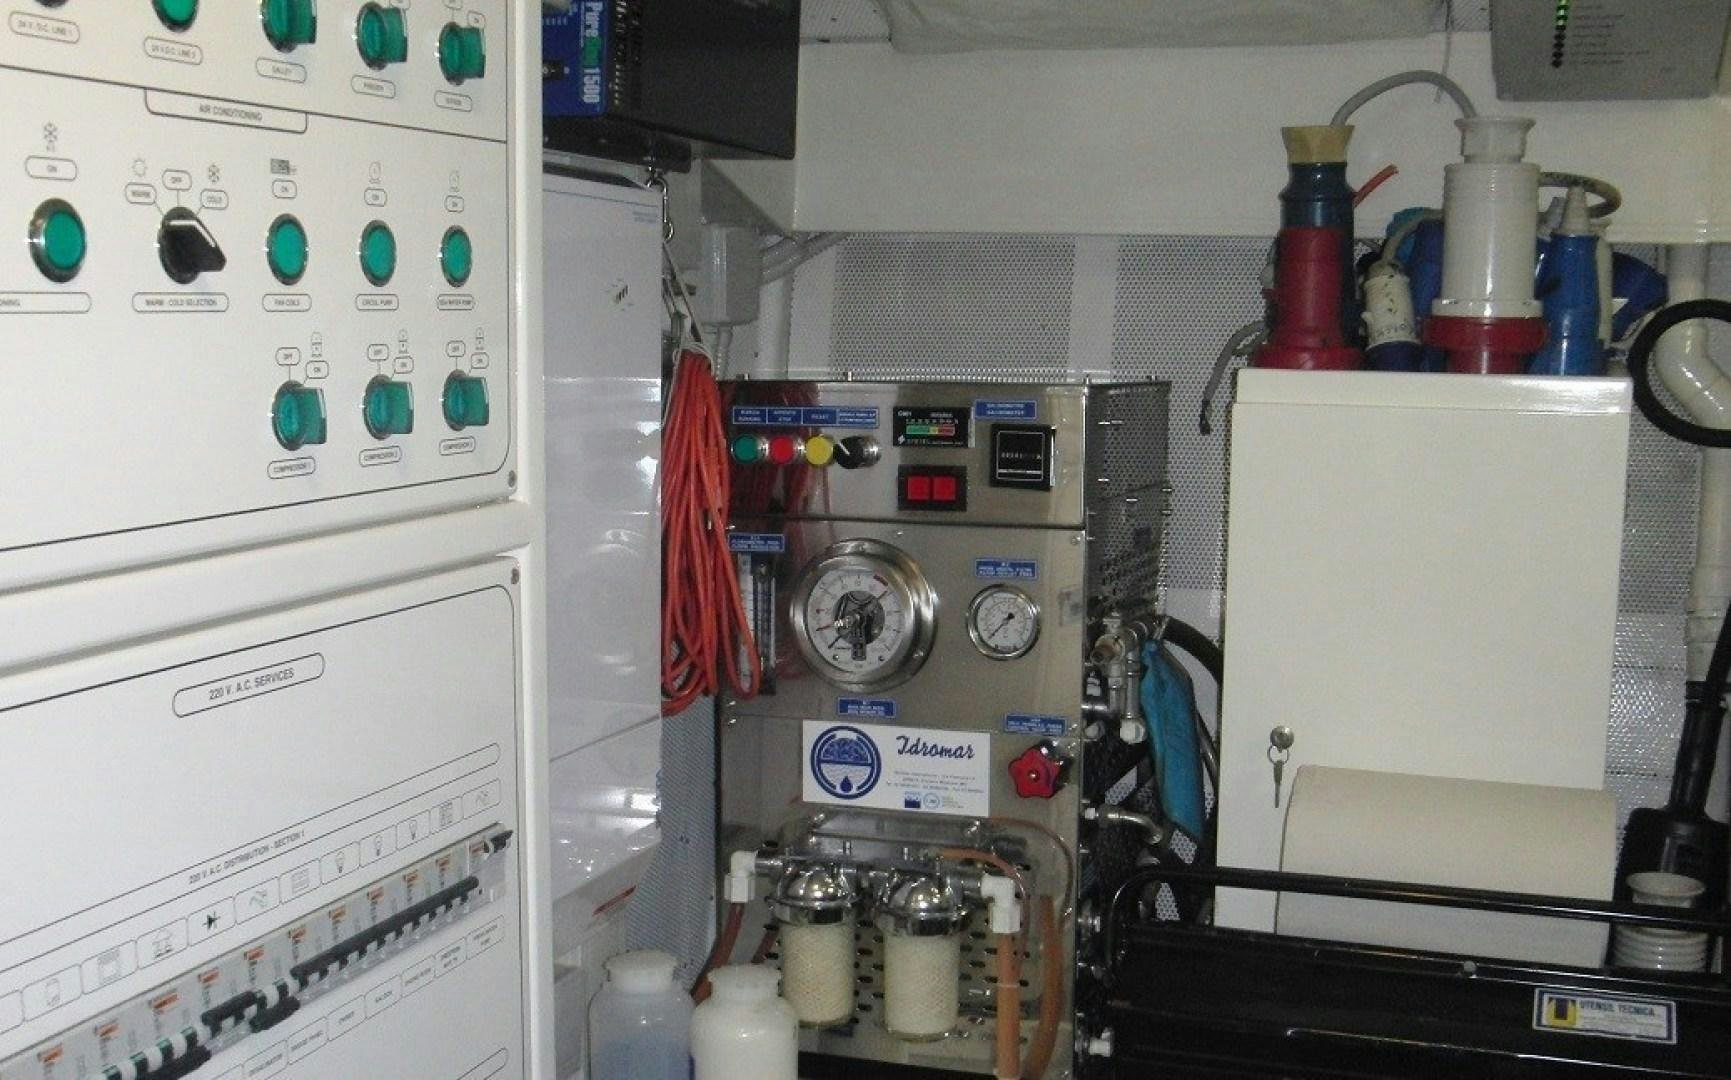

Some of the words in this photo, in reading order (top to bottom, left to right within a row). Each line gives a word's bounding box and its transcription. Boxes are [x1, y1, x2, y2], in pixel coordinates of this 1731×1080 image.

[584, 68, 600, 103] 1500
[199, 103, 212, 114] AIR
[213, 105, 263, 122] CONDITIONING
[206, 195, 222, 203] COLD
[168, 298, 185, 306] COLD
[186, 298, 217, 306] SELECTION
[209, 687, 223, 700] 220
[236, 679, 252, 693] A.C.
[254, 667, 295, 688] SERVICES
[895, 734, 976, 760] Idromar
[223, 846, 270, 870] DISTRIBUTION
[275, 832, 302, 851] SECTION
